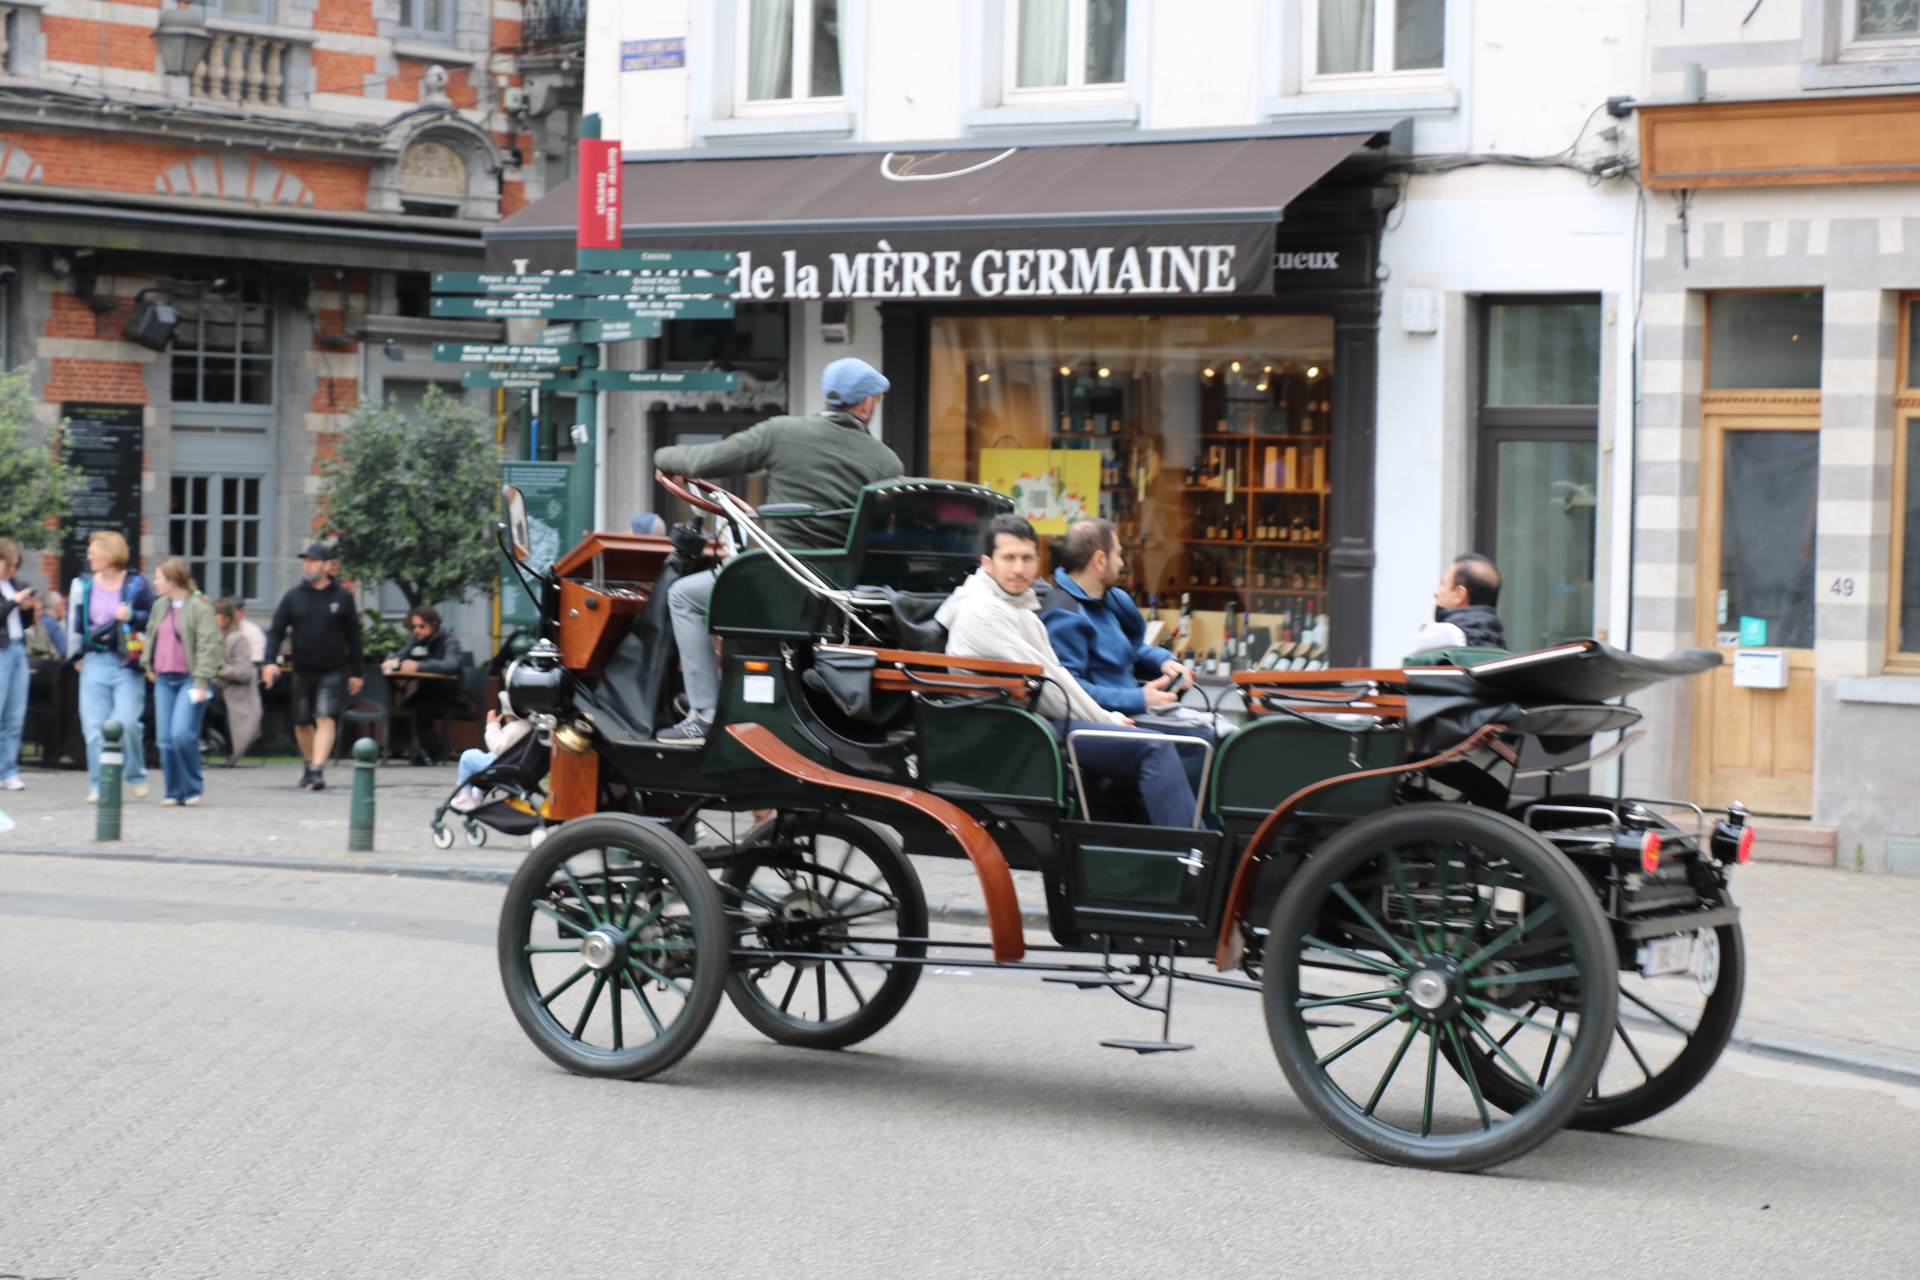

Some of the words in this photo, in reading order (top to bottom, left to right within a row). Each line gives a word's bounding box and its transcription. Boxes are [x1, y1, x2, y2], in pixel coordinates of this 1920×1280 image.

[728, 250, 775, 299] de
[782, 250, 821, 299] la
[828, 239, 962, 298] MÈRE
[970, 245, 1237, 298] GERMAINE
[509, 346, 521, 354] de
[1830, 577, 1855, 597] 49
